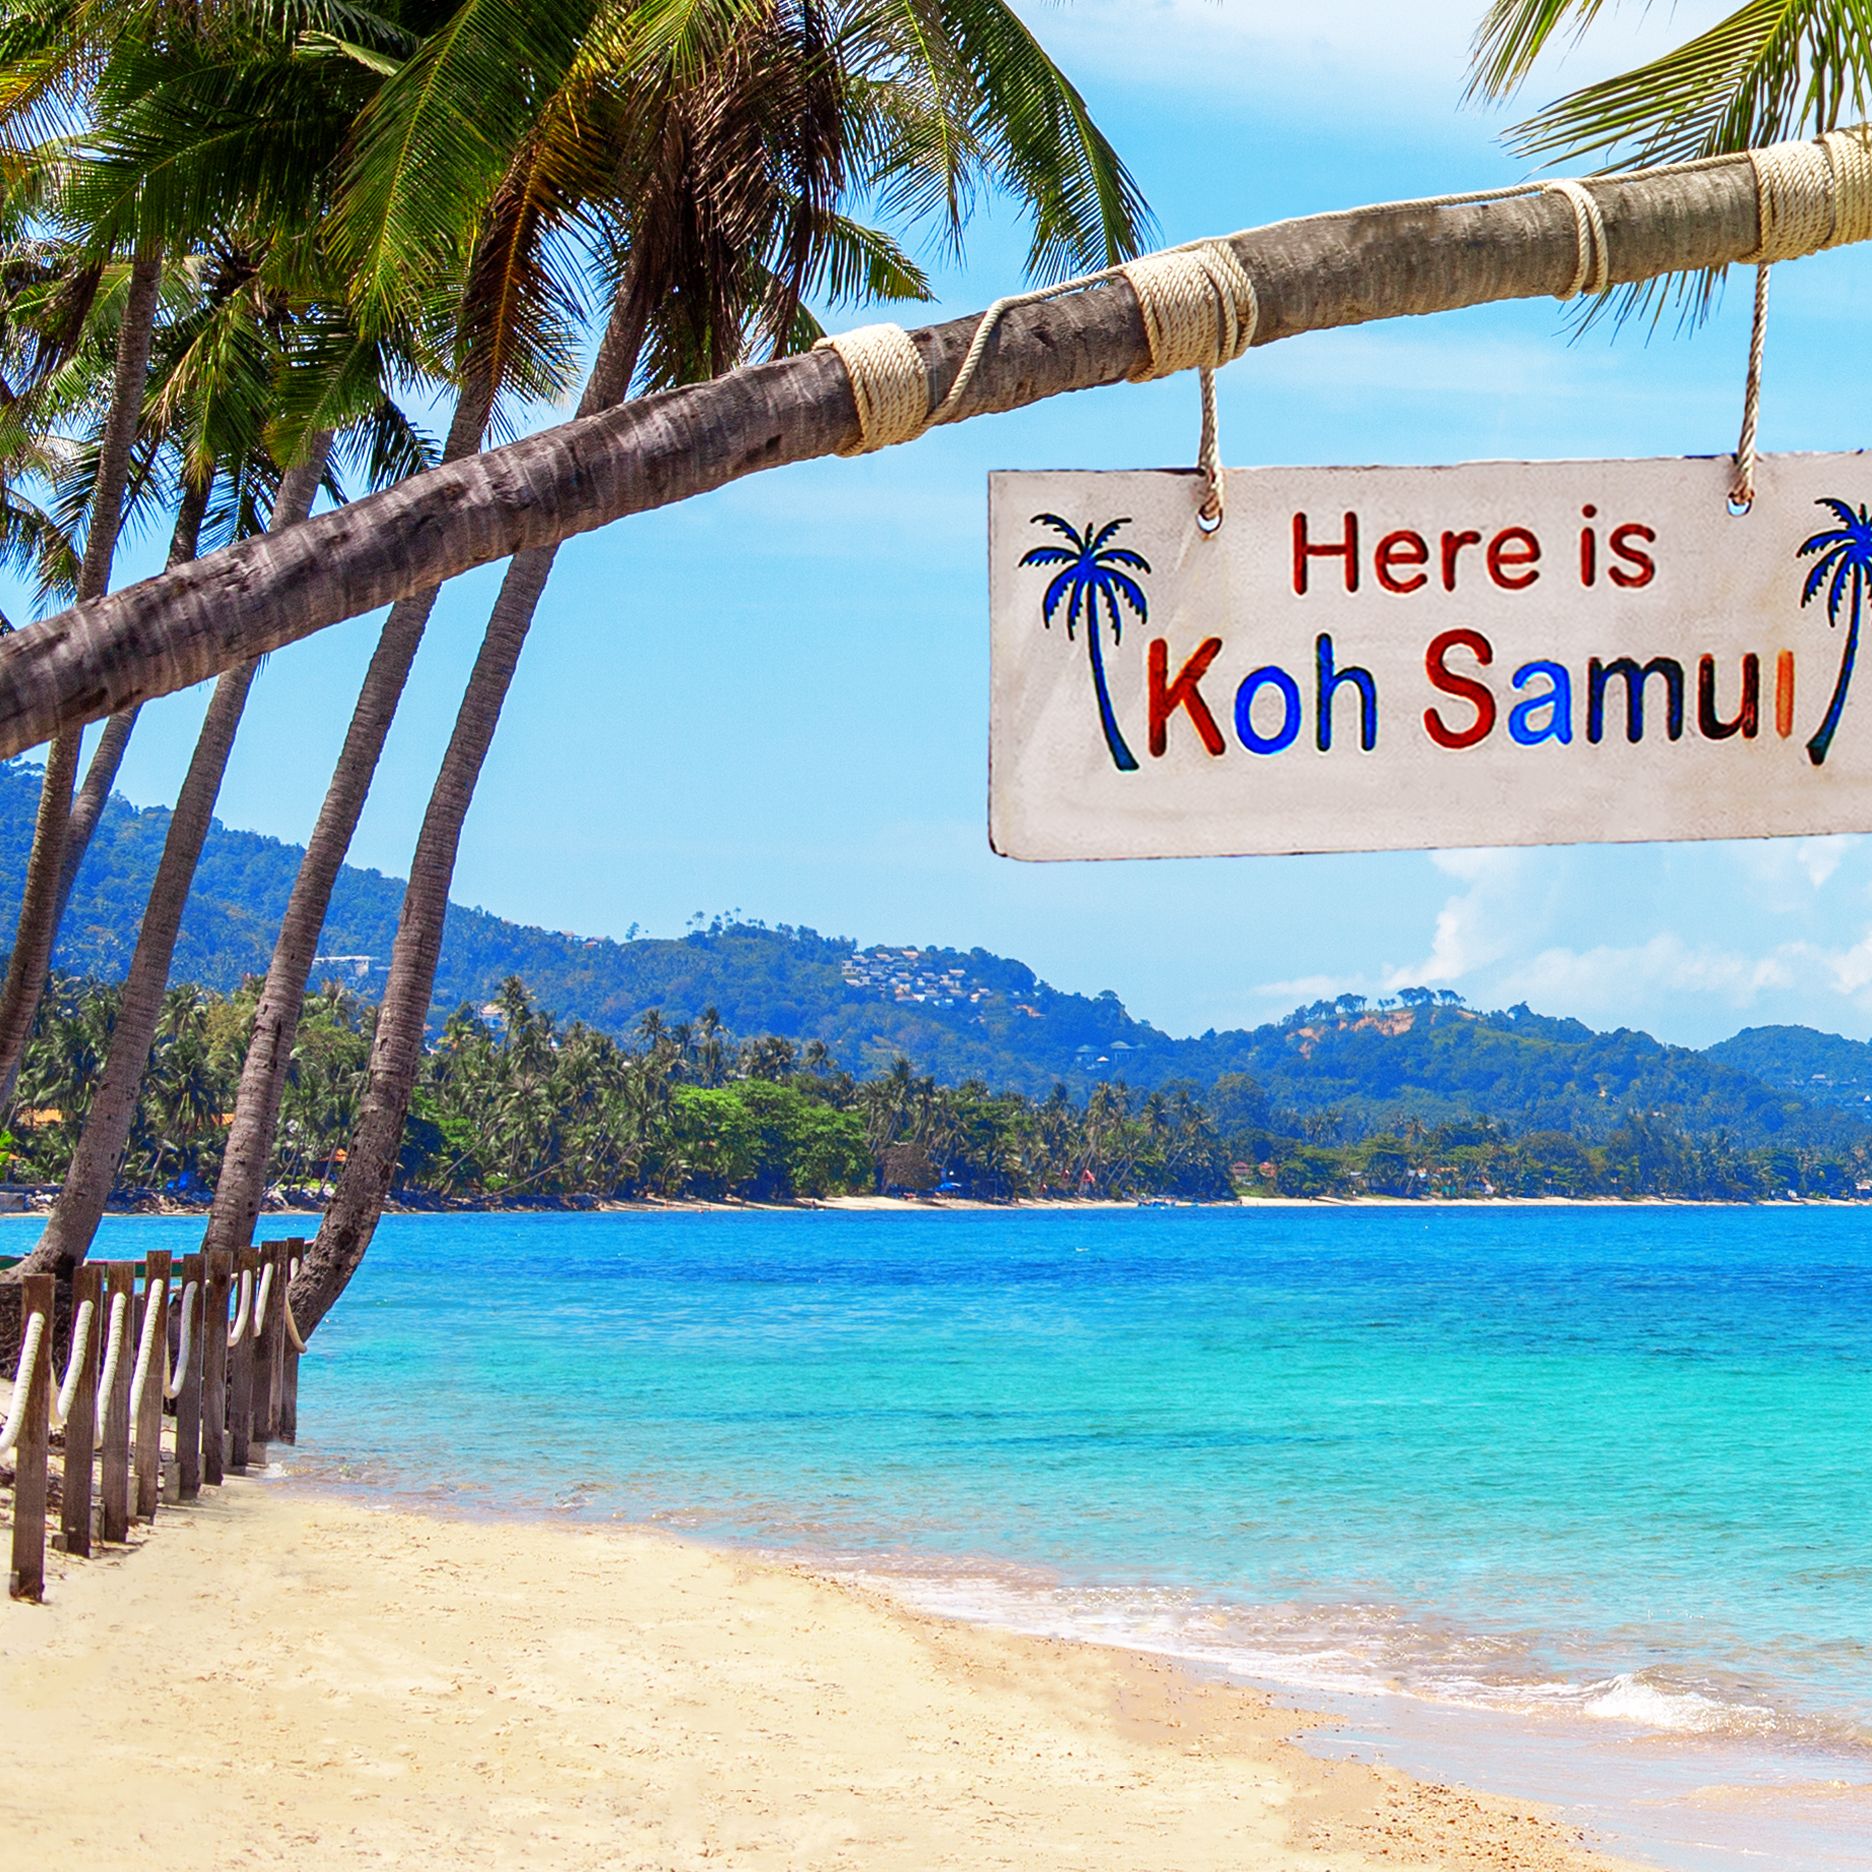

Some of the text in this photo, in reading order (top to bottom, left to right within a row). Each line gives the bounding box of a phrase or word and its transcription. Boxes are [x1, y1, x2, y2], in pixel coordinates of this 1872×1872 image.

[1291, 504, 1656, 595] Here is
[1147, 632, 1378, 757] Koh
